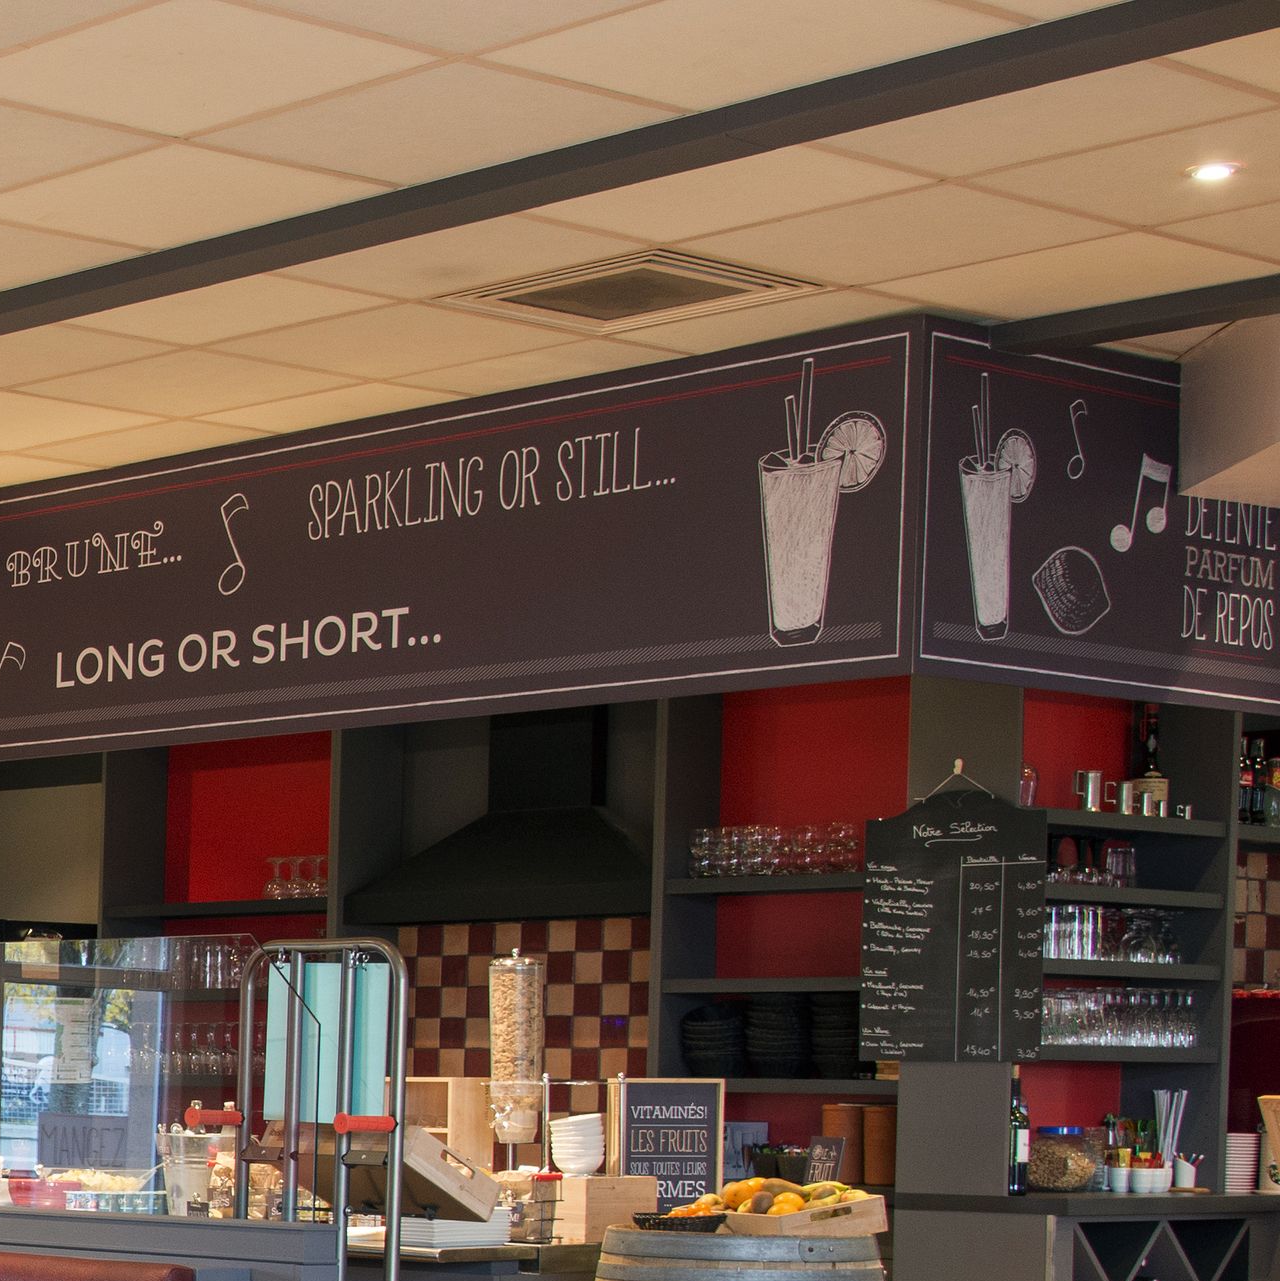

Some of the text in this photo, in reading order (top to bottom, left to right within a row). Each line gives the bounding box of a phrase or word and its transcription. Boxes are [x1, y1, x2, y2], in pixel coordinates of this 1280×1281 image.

[308, 427, 676, 541] SPARKLING OR STILL...
[7, 520, 183, 589] BRUNE...
[1185, 547, 1276, 590] PARFUM
[1181, 585, 1275, 651] DE REPOS
[55, 607, 442, 689] LONG OR SHORT...
[913, 821, 1000, 839] Notre Sélection
[630, 1102, 708, 1119] VITAMINÉS!
[630, 1129, 707, 1153] LES FRUITS
[630, 1161, 707, 1176] SOUS TOUTES LEURS
[656, 1180, 706, 1198] RMES
